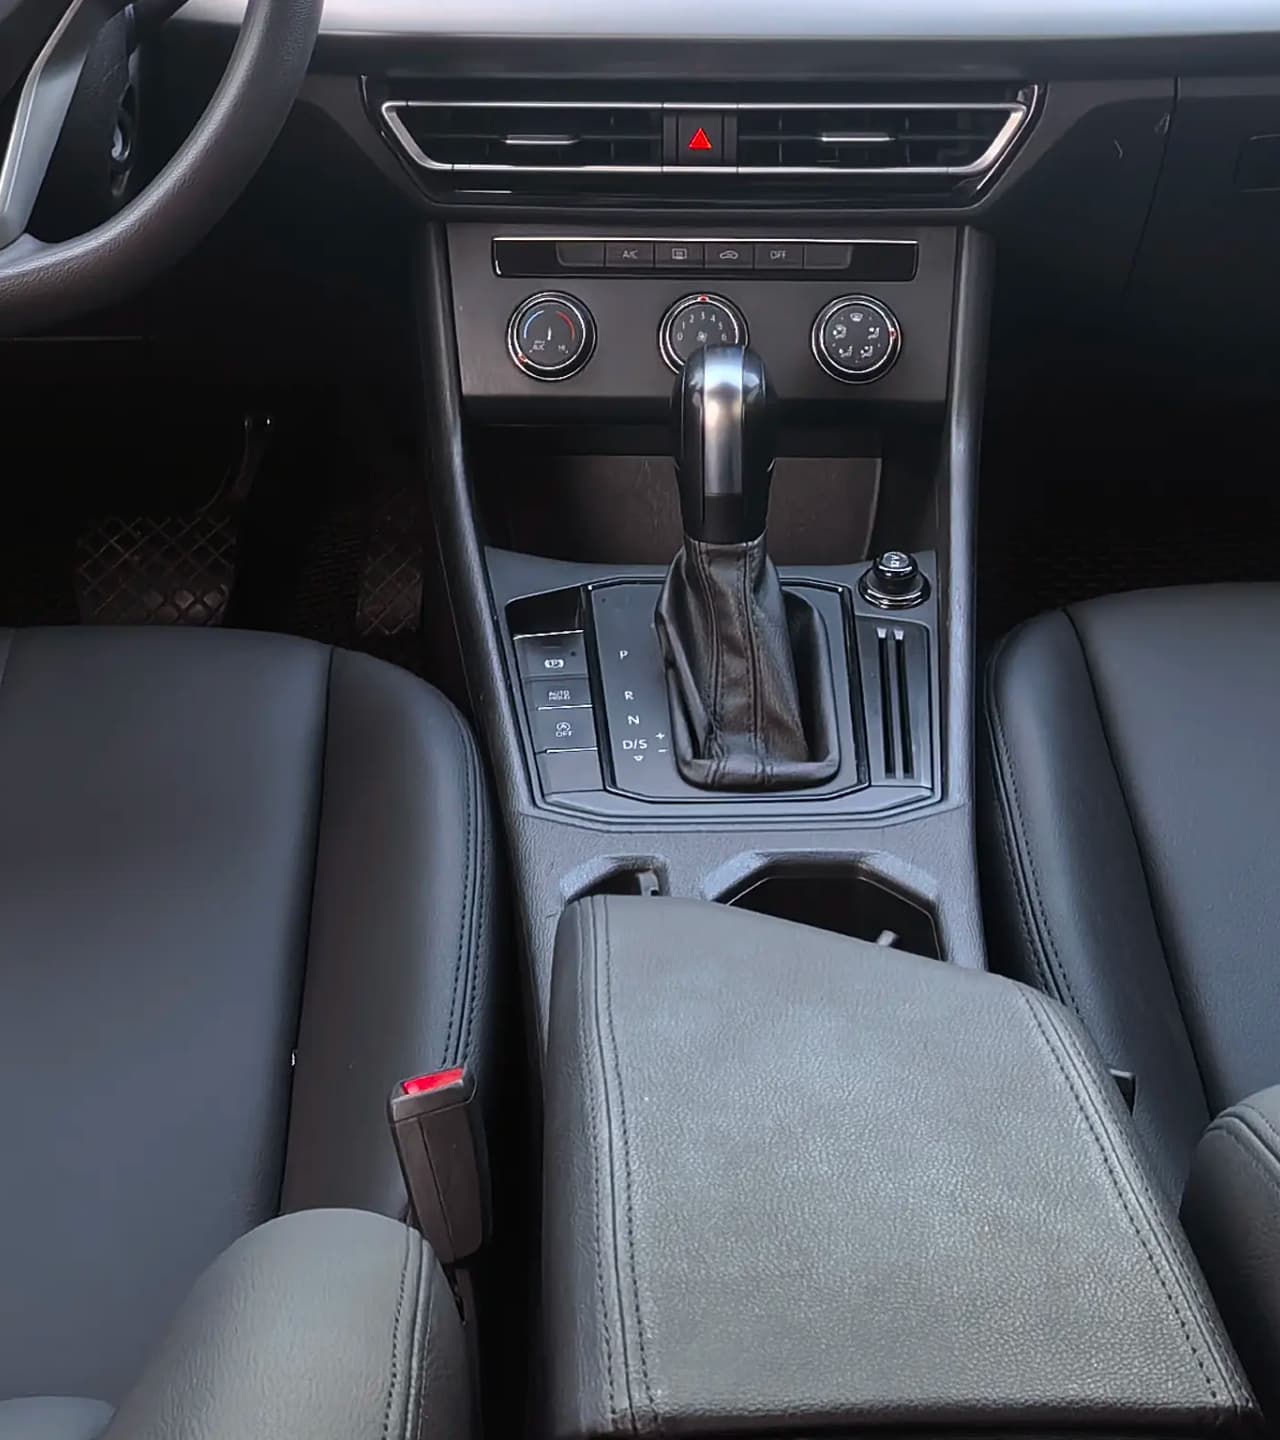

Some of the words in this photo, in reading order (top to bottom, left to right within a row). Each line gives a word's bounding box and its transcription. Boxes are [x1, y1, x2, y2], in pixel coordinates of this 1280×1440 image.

[622, 249, 639, 259] A/C
[770, 250, 786, 259] OFF
[620, 650, 628, 659] P
[624, 691, 634, 700] R
[627, 715, 639, 724] N
[622, 739, 648, 749] D/S
